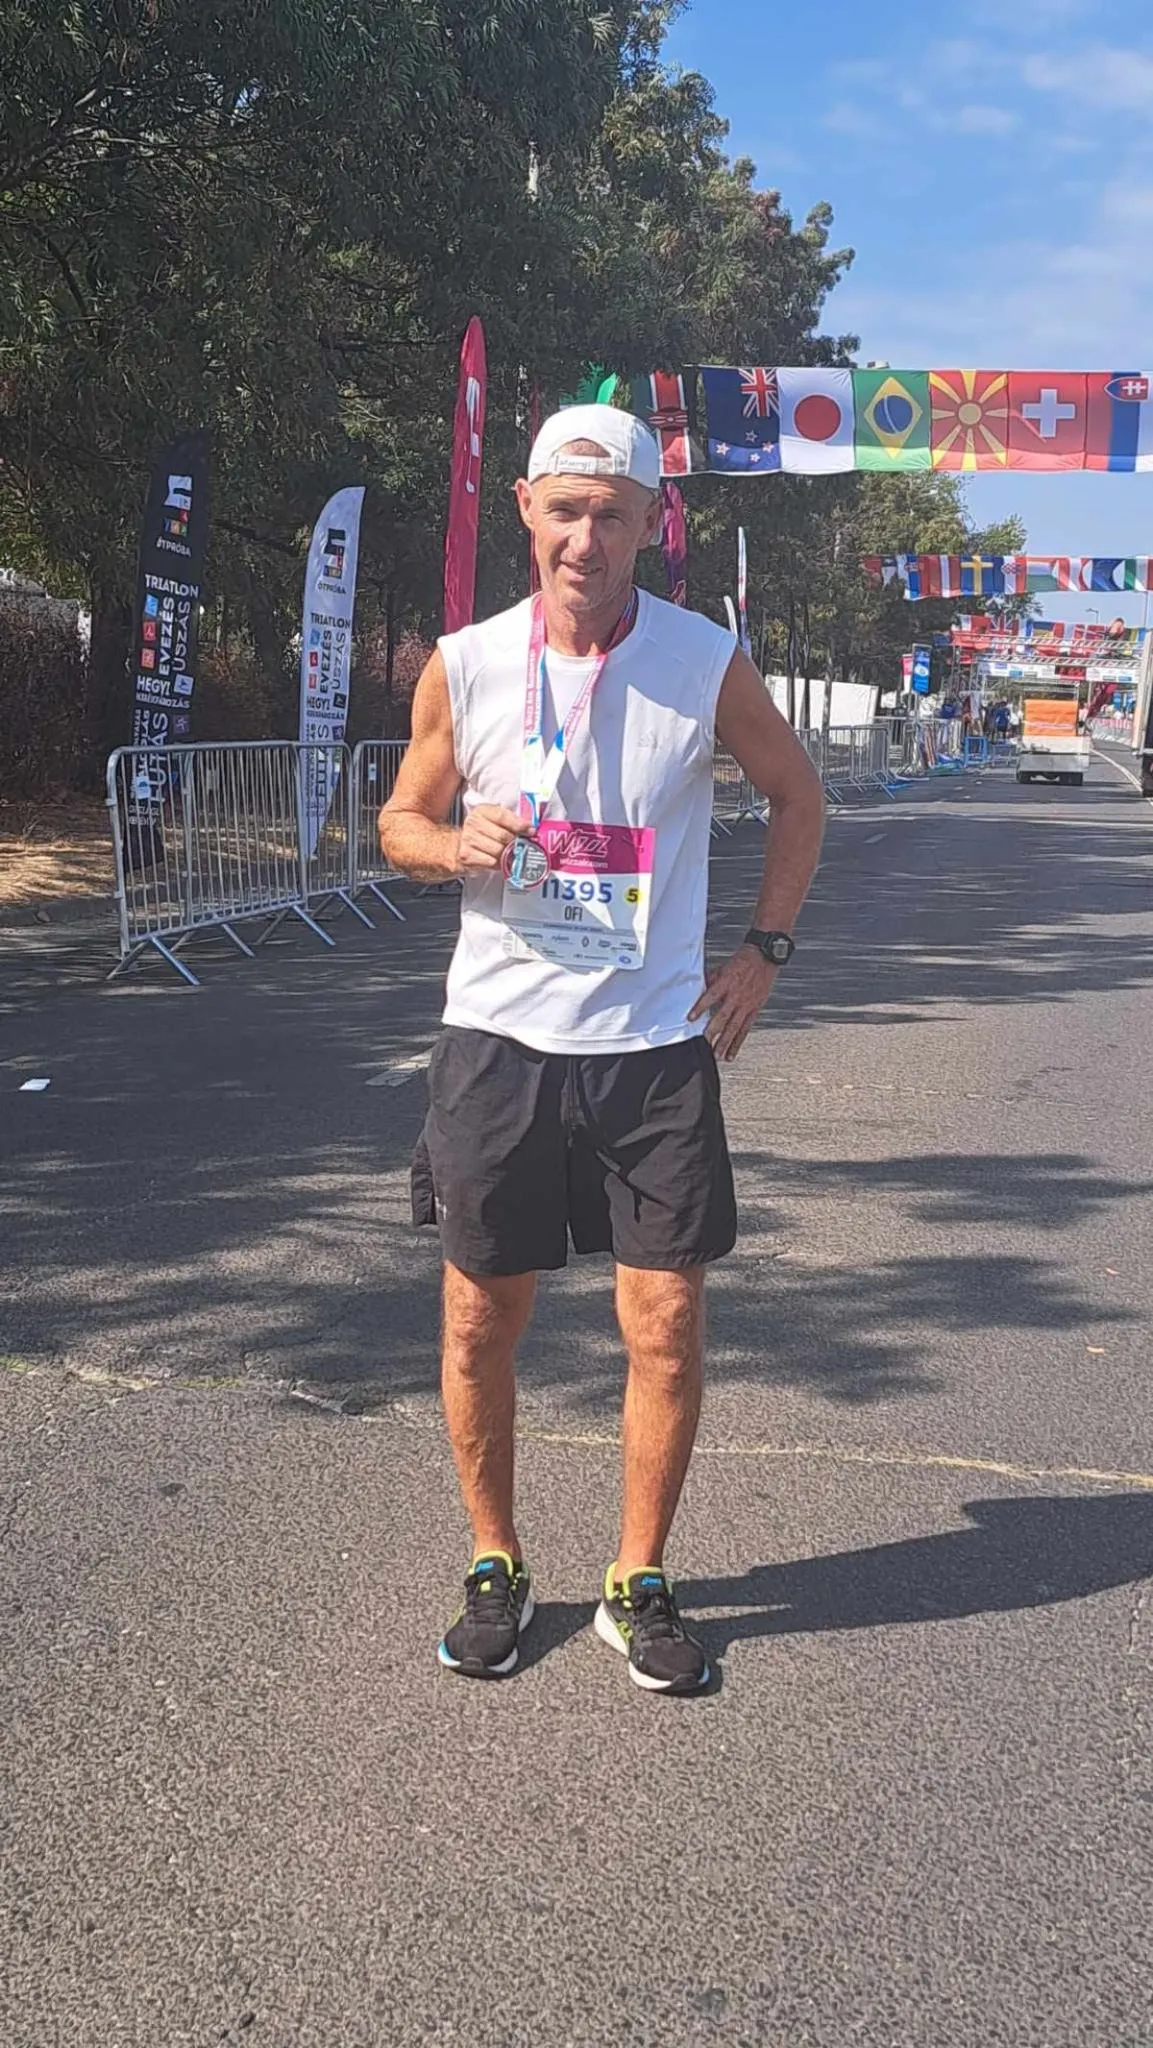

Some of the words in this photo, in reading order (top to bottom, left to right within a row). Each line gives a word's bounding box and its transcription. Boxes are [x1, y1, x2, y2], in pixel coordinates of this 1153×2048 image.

[145, 574, 199, 598] TRIATLON
[310, 612, 350, 629] TRIATLON
[158, 597, 175, 675] EVEZÉS
[172, 600, 191, 672] ÚSZÁS
[320, 630, 332, 693] EVEZÉS
[136, 675, 171, 697] HEGYI
[541, 879, 612, 903] 11395
[626, 888, 639, 903] 5
[564, 906, 582, 921] OFI
